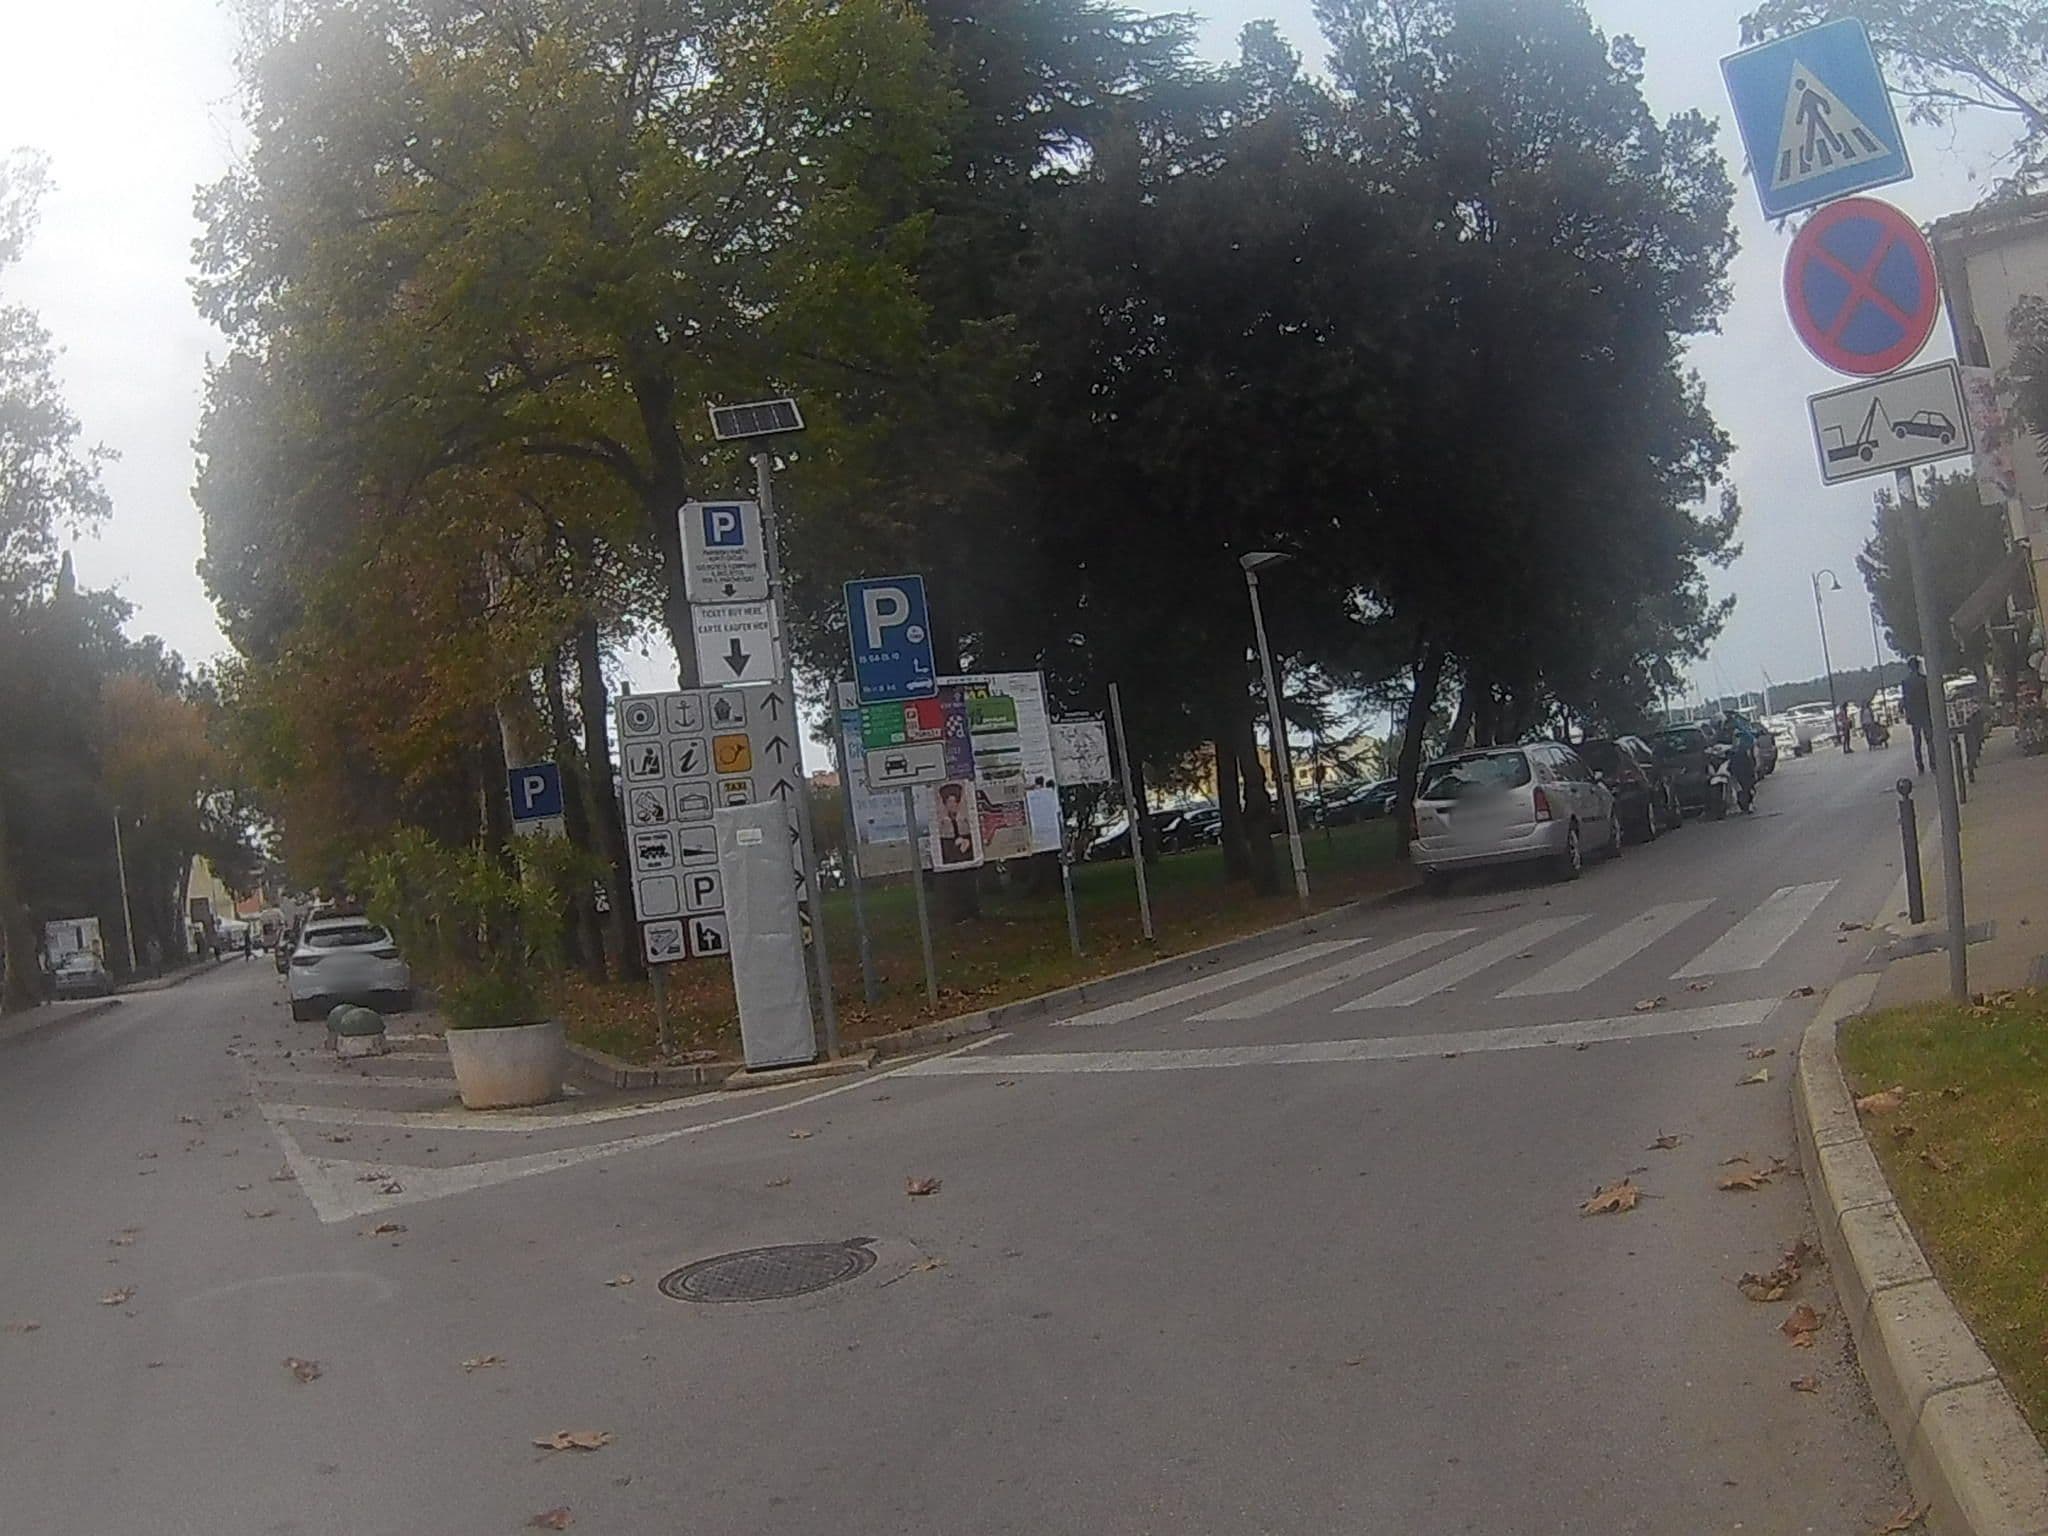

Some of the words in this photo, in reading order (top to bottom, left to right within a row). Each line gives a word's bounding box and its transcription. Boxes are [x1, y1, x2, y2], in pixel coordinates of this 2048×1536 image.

[712, 511, 735, 543] P
[863, 587, 910, 649] P
[523, 775, 545, 809] P
[724, 782, 747, 792] TAXI
[694, 876, 715, 905] P
